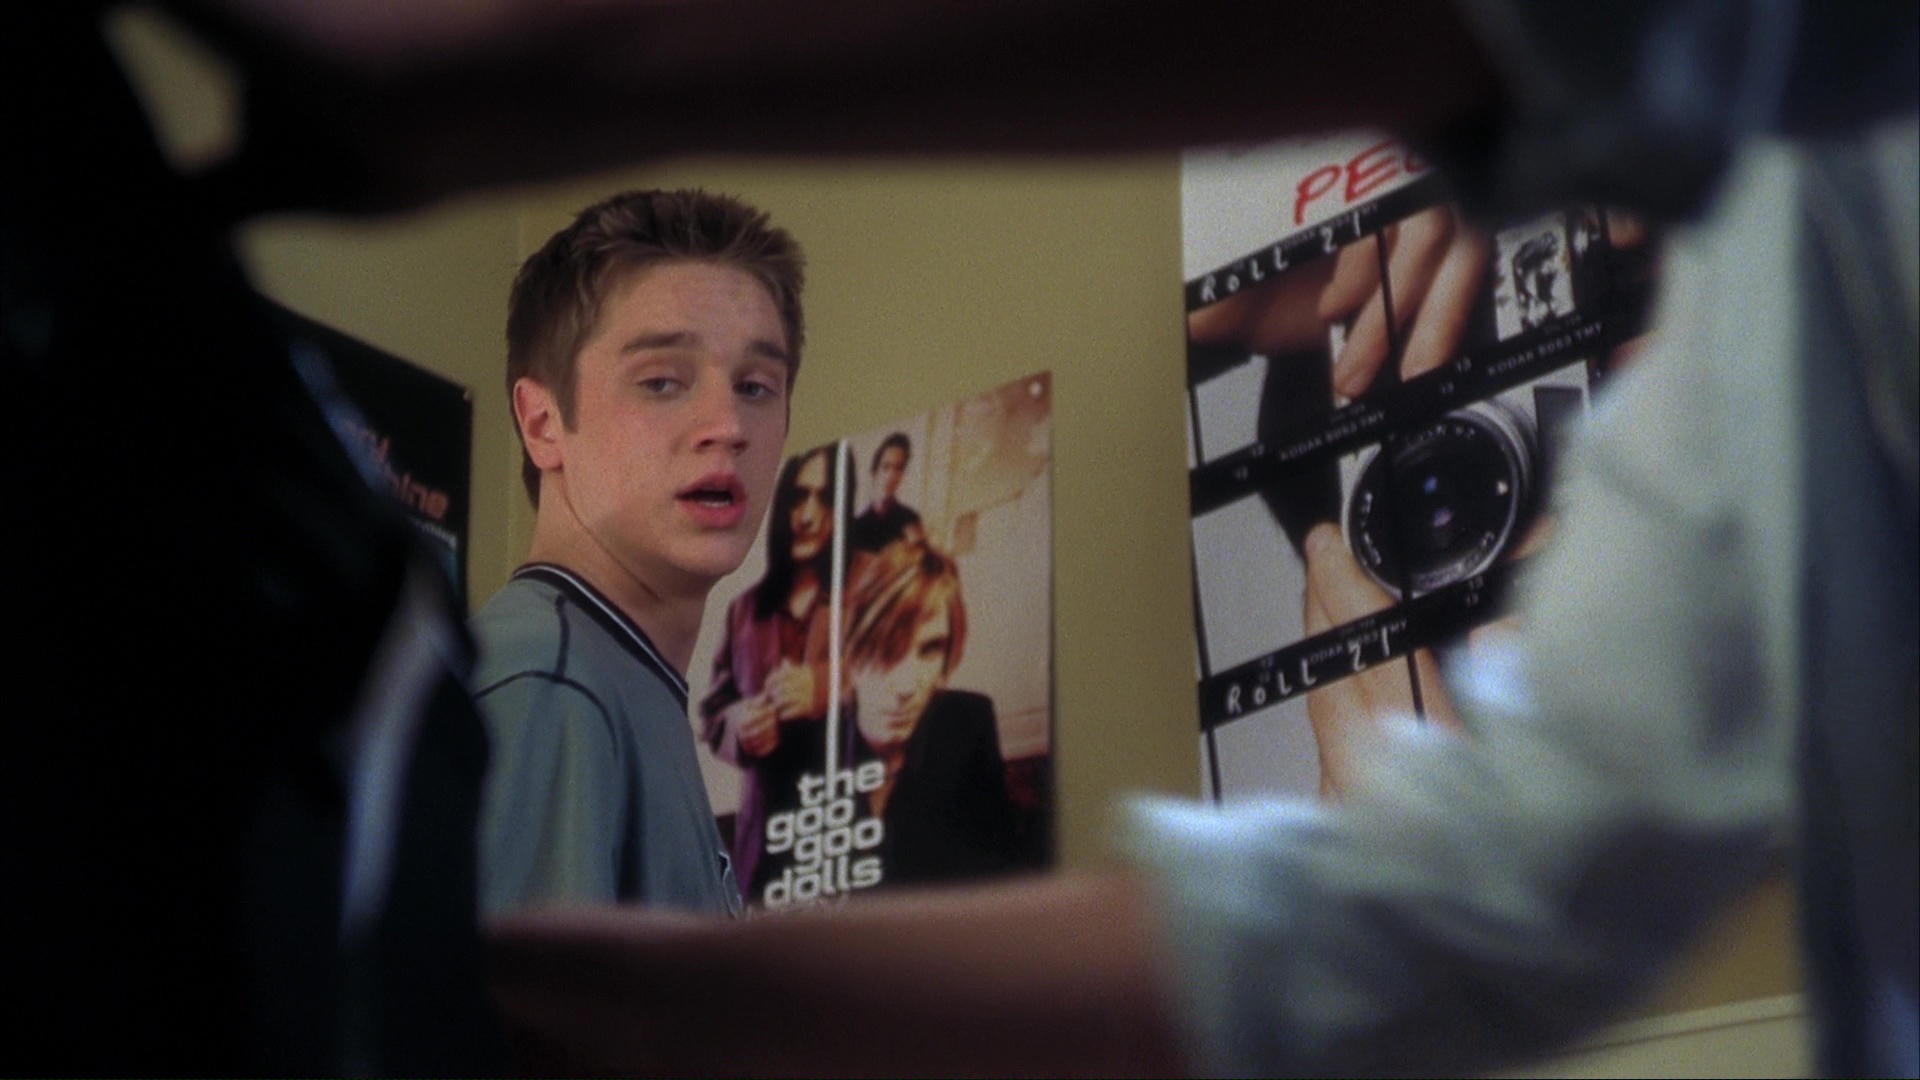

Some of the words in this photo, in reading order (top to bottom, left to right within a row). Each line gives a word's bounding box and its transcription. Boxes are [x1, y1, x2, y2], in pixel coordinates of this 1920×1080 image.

[1349, 625, 1391, 673] 21
[797, 757, 886, 808] the
[766, 798, 855, 855] goo
[793, 816, 883, 874] goo
[763, 855, 882, 910] dolls
